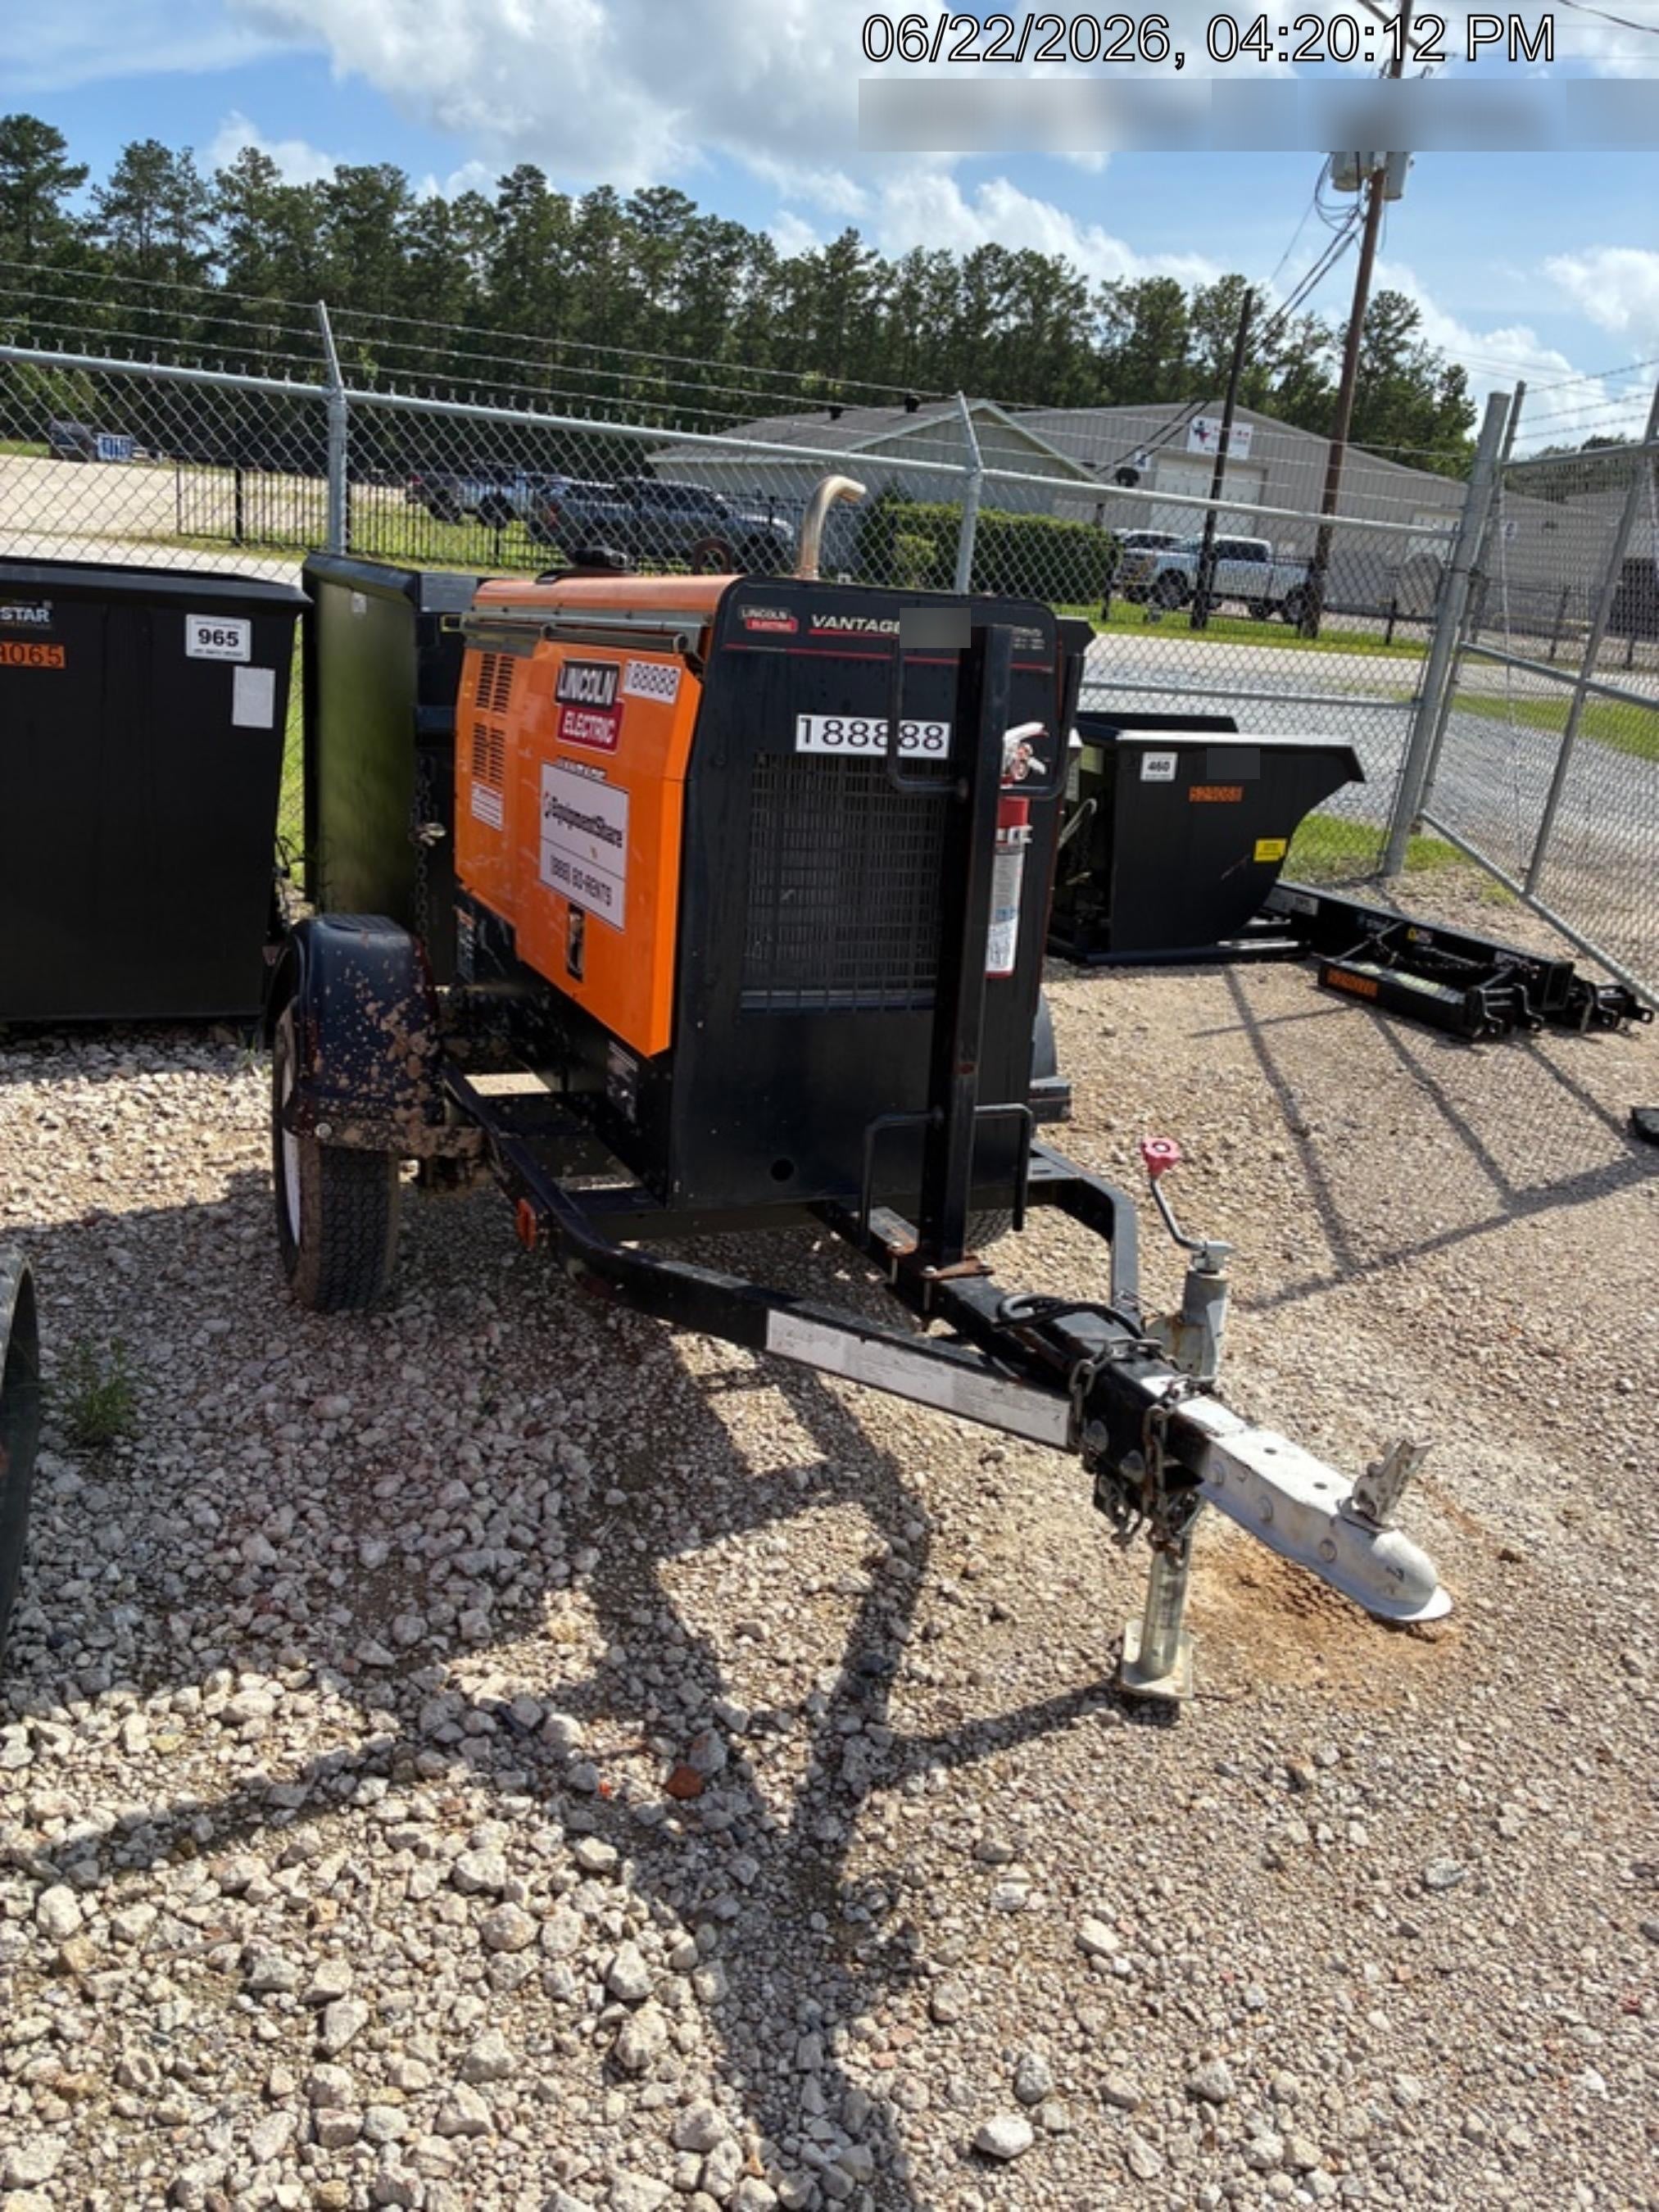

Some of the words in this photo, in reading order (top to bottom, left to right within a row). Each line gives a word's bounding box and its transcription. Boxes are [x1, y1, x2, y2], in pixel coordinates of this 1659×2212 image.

[742, 609, 787, 619] LINCOLN
[198, 628, 239, 647] 965
[558, 666, 617, 705] LINCOLN
[563, 709, 616, 744] ELECTRIC
[800, 717, 943, 750] 188888
[1149, 760, 1170, 773] 460
[551, 796, 623, 849] EquipmentShare
